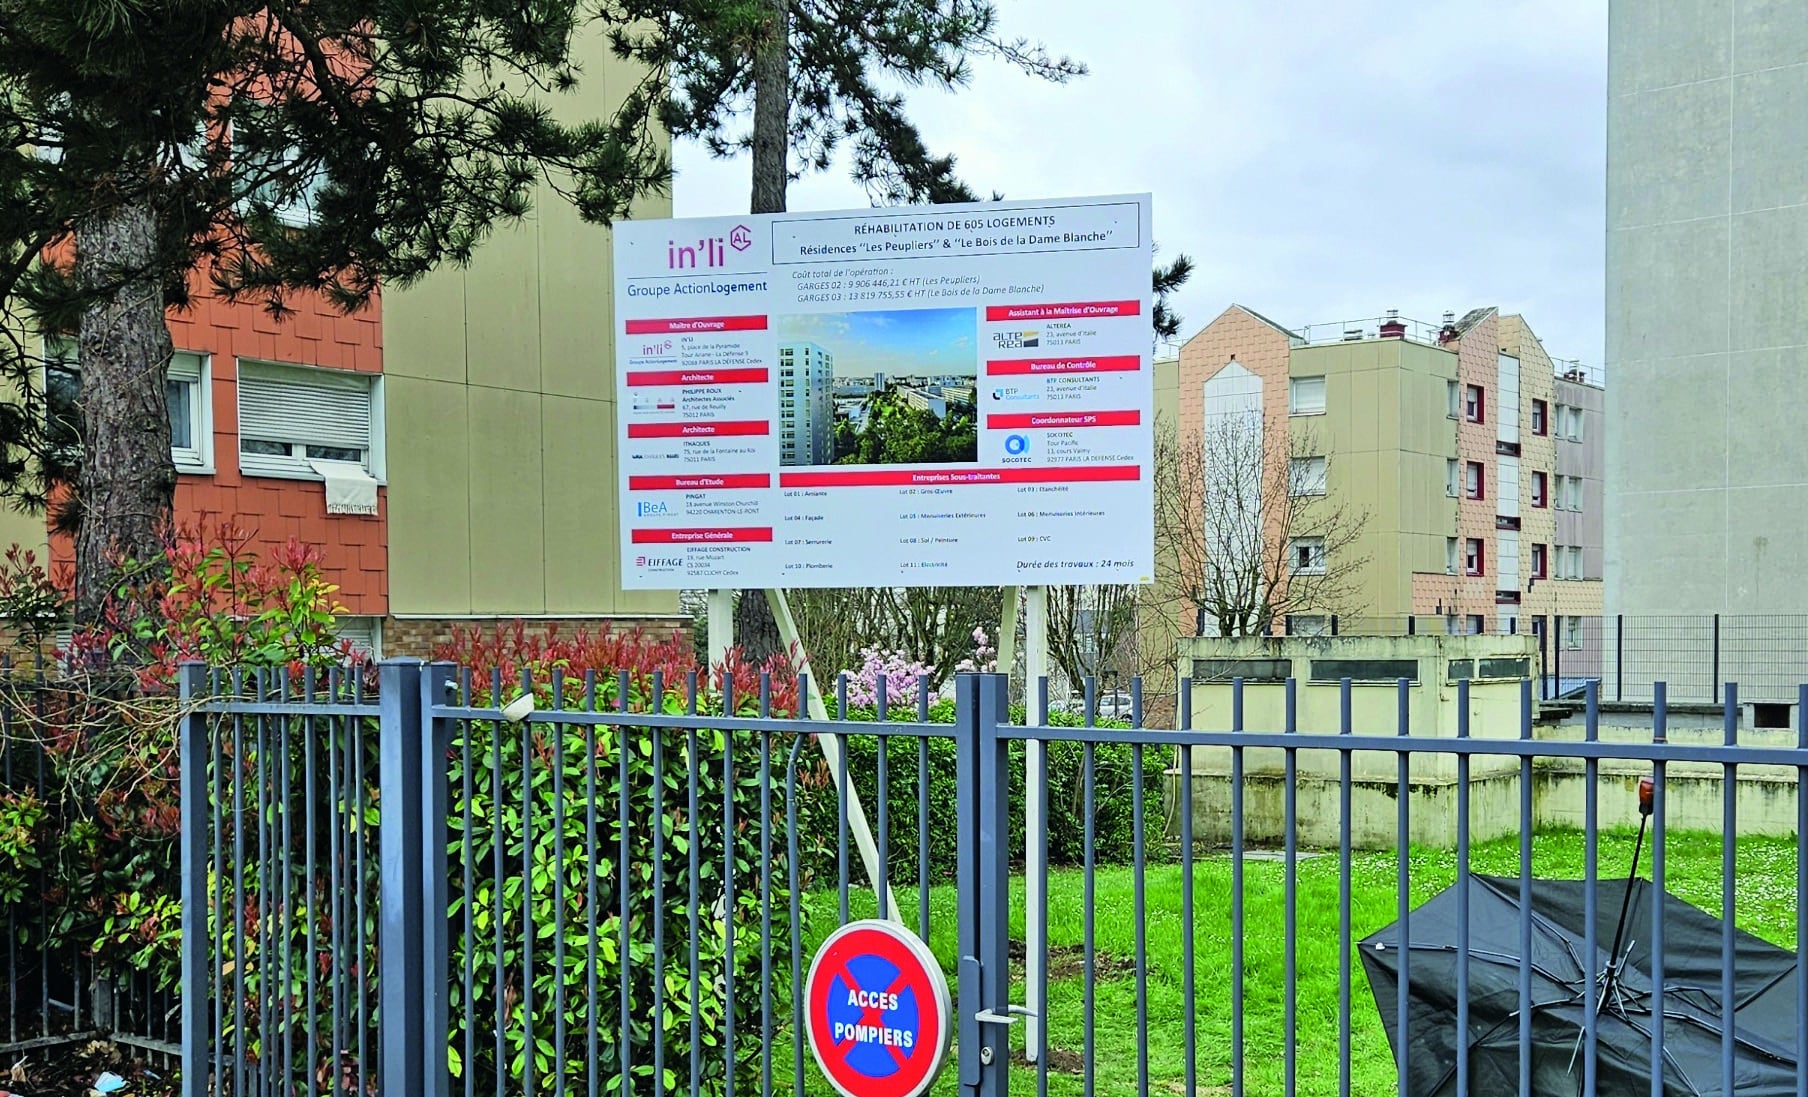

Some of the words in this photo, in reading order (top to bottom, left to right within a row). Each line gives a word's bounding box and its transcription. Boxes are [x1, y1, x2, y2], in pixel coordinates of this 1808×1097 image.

[855, 222, 943, 235] RÉHABILITATION
[947, 221, 961, 230] DE
[965, 220, 983, 229] 605
[987, 216, 1055, 228] LOGEMENTS
[800, 244, 856, 255] Résidences
[943, 239, 951, 249] &
[976, 237, 997, 247] Bois
[1001, 236, 1013, 246] de
[1017, 235, 1025, 245] la
[1029, 235, 1060, 244] Dame
[668, 238, 724, 269] in'li
[792, 271, 810, 279] Coût
[813, 269, 831, 278] total
[845, 268, 888, 277] l'opération
[798, 282, 830, 290] GARGES
[855, 280, 870, 288] 906
[872, 279, 899, 288] 446,21
[923, 278, 938, 286] (Les
[940, 276, 980, 285] Peupliers)
[628, 285, 670, 299] Groupe
[674, 281, 767, 295] ActionLogement
[798, 294, 830, 302] GARGES
[861, 292, 876, 300] 819
[878, 291, 905, 299] 755,55
[928, 289, 939, 297] (Le
[961, 288, 971, 296] de
[973, 287, 980, 295] la
[983, 286, 1006, 295] Dame
[1009, 284, 1044, 294] Blanche)
[1083, 306, 1118, 314] d'Ouvrage
[692, 321, 724, 329] d'Ouvrage
[643, 344, 663, 355] in'li
[1067, 361, 1096, 369] Contrôle
[912, 474, 949, 482] Entreprises
[951, 473, 1000, 481] Sous-traitantes
[672, 532, 703, 540] Entreprise
[705, 531, 733, 539] Générale
[648, 558, 682, 566] EIFFAGE
[1017, 560, 1042, 568] Durée
[848, 989, 898, 1010] ACCES
[835, 1022, 913, 1047] POMPIERS
